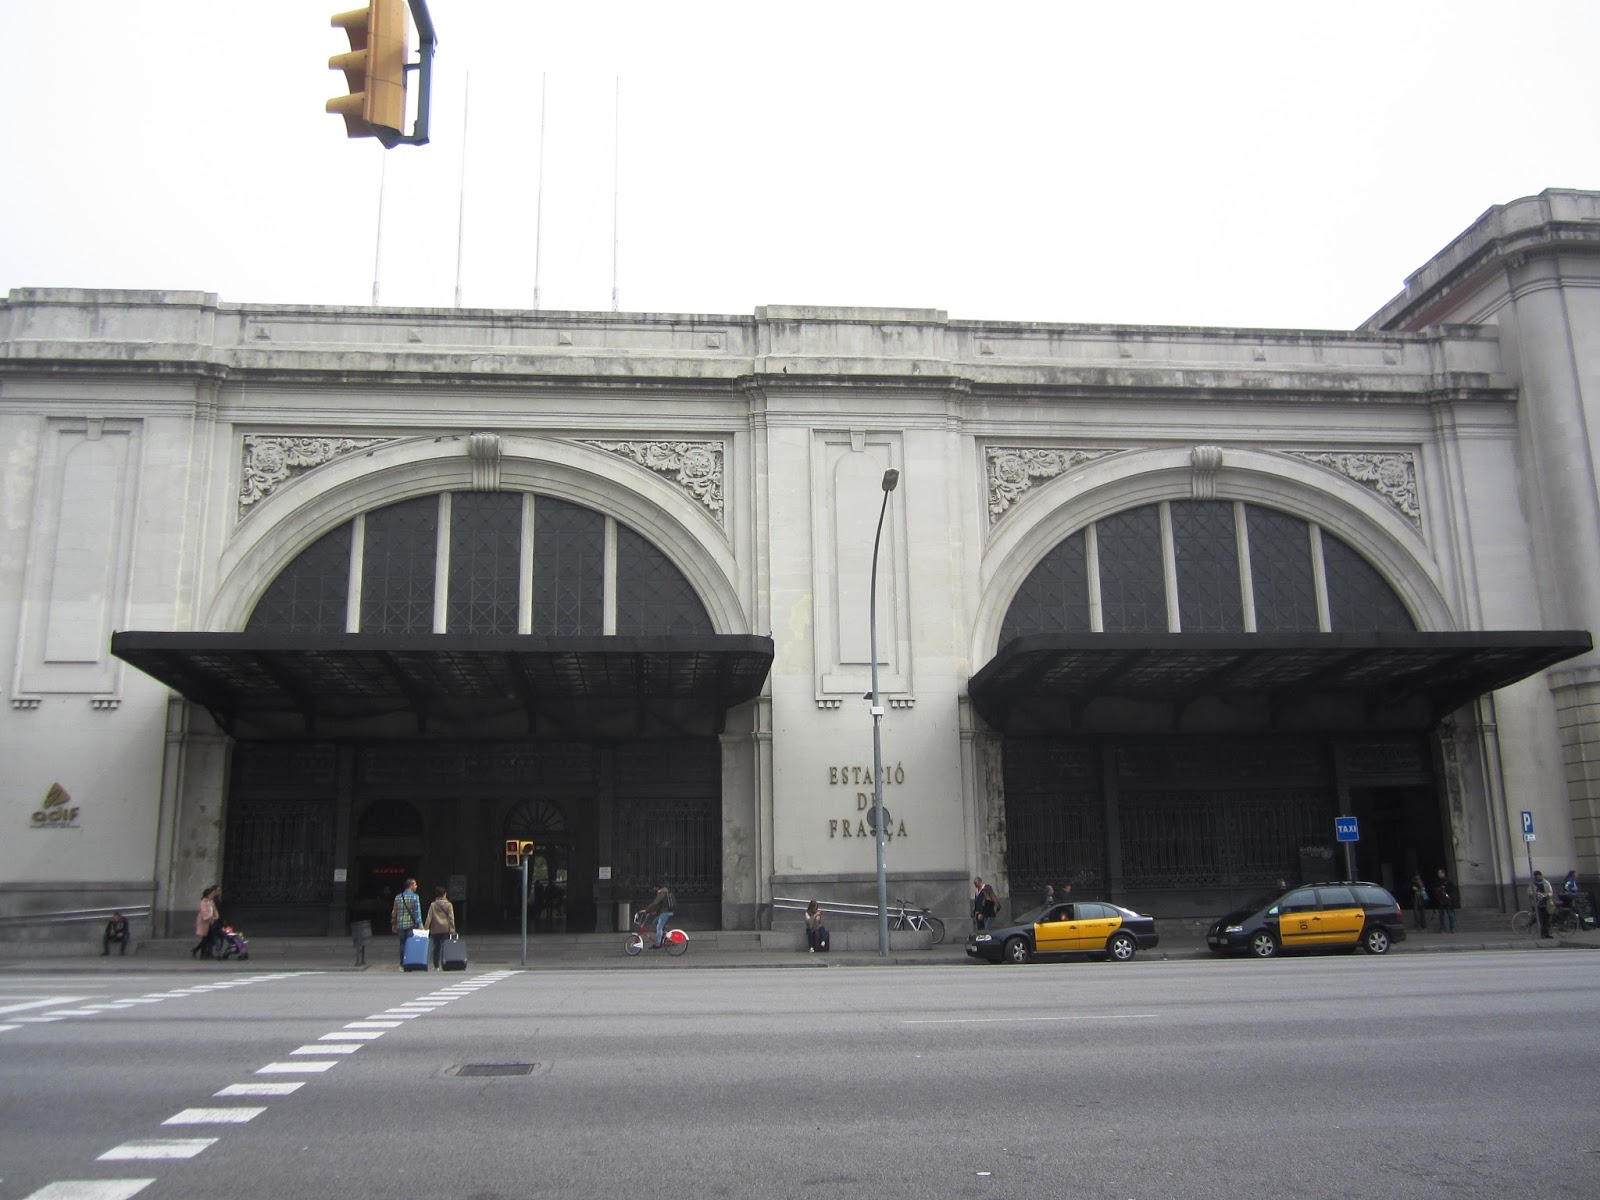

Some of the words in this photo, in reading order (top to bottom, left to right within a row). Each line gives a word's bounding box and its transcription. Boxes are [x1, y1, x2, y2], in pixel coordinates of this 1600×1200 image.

[829, 761, 905, 785] ESTAIÓ
[829, 819, 908, 842] FRAÇA
[1337, 825, 1357, 833] TAXI
[1523, 813, 1531, 831] P
